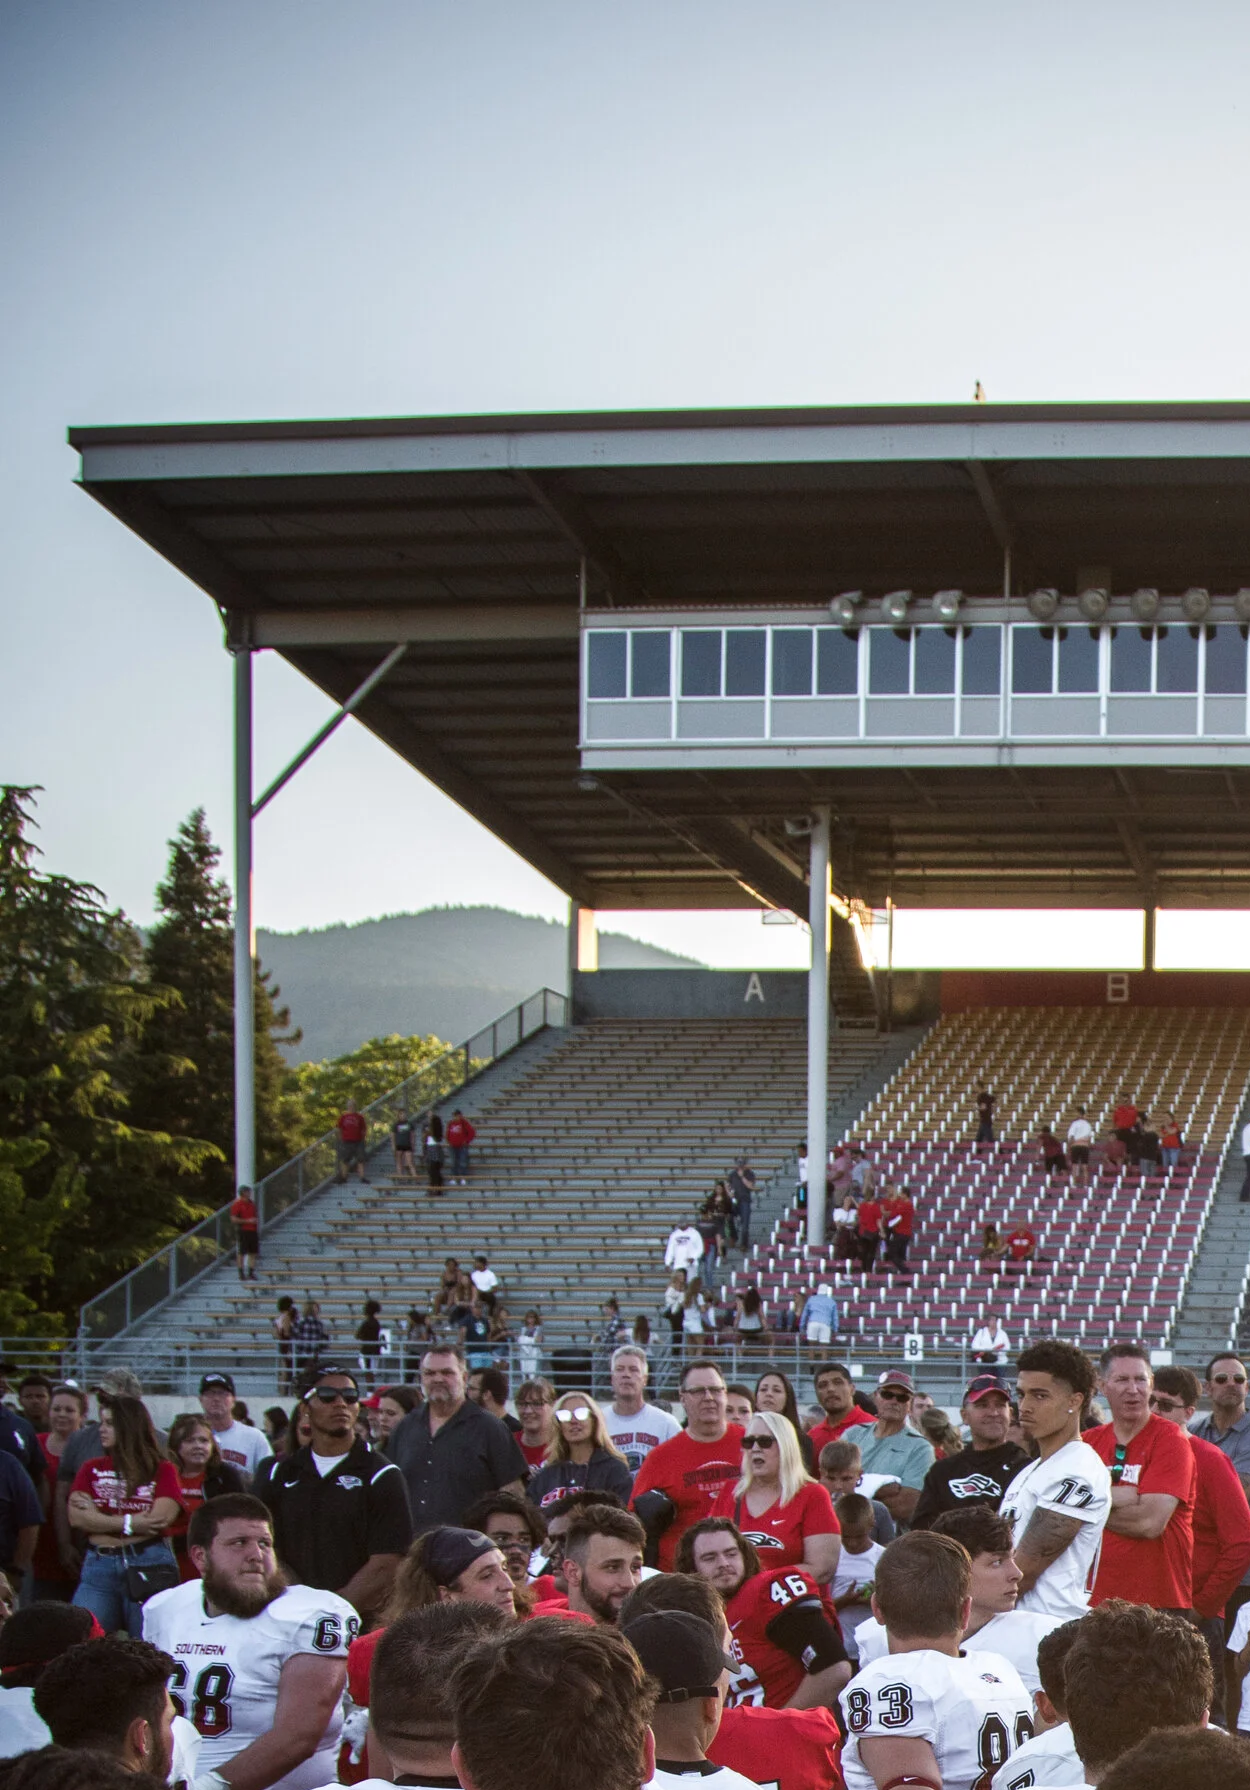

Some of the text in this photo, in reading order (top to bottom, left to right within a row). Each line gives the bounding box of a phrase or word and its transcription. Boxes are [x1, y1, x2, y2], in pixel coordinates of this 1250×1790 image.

[744, 972, 765, 1002] A
[1107, 973, 1128, 1002] B
[909, 1339, 918, 1356] B
[770, 1574, 809, 1607] 46
[174, 1643, 227, 1657] SOUTHERN
[846, 1682, 915, 1733] 83
